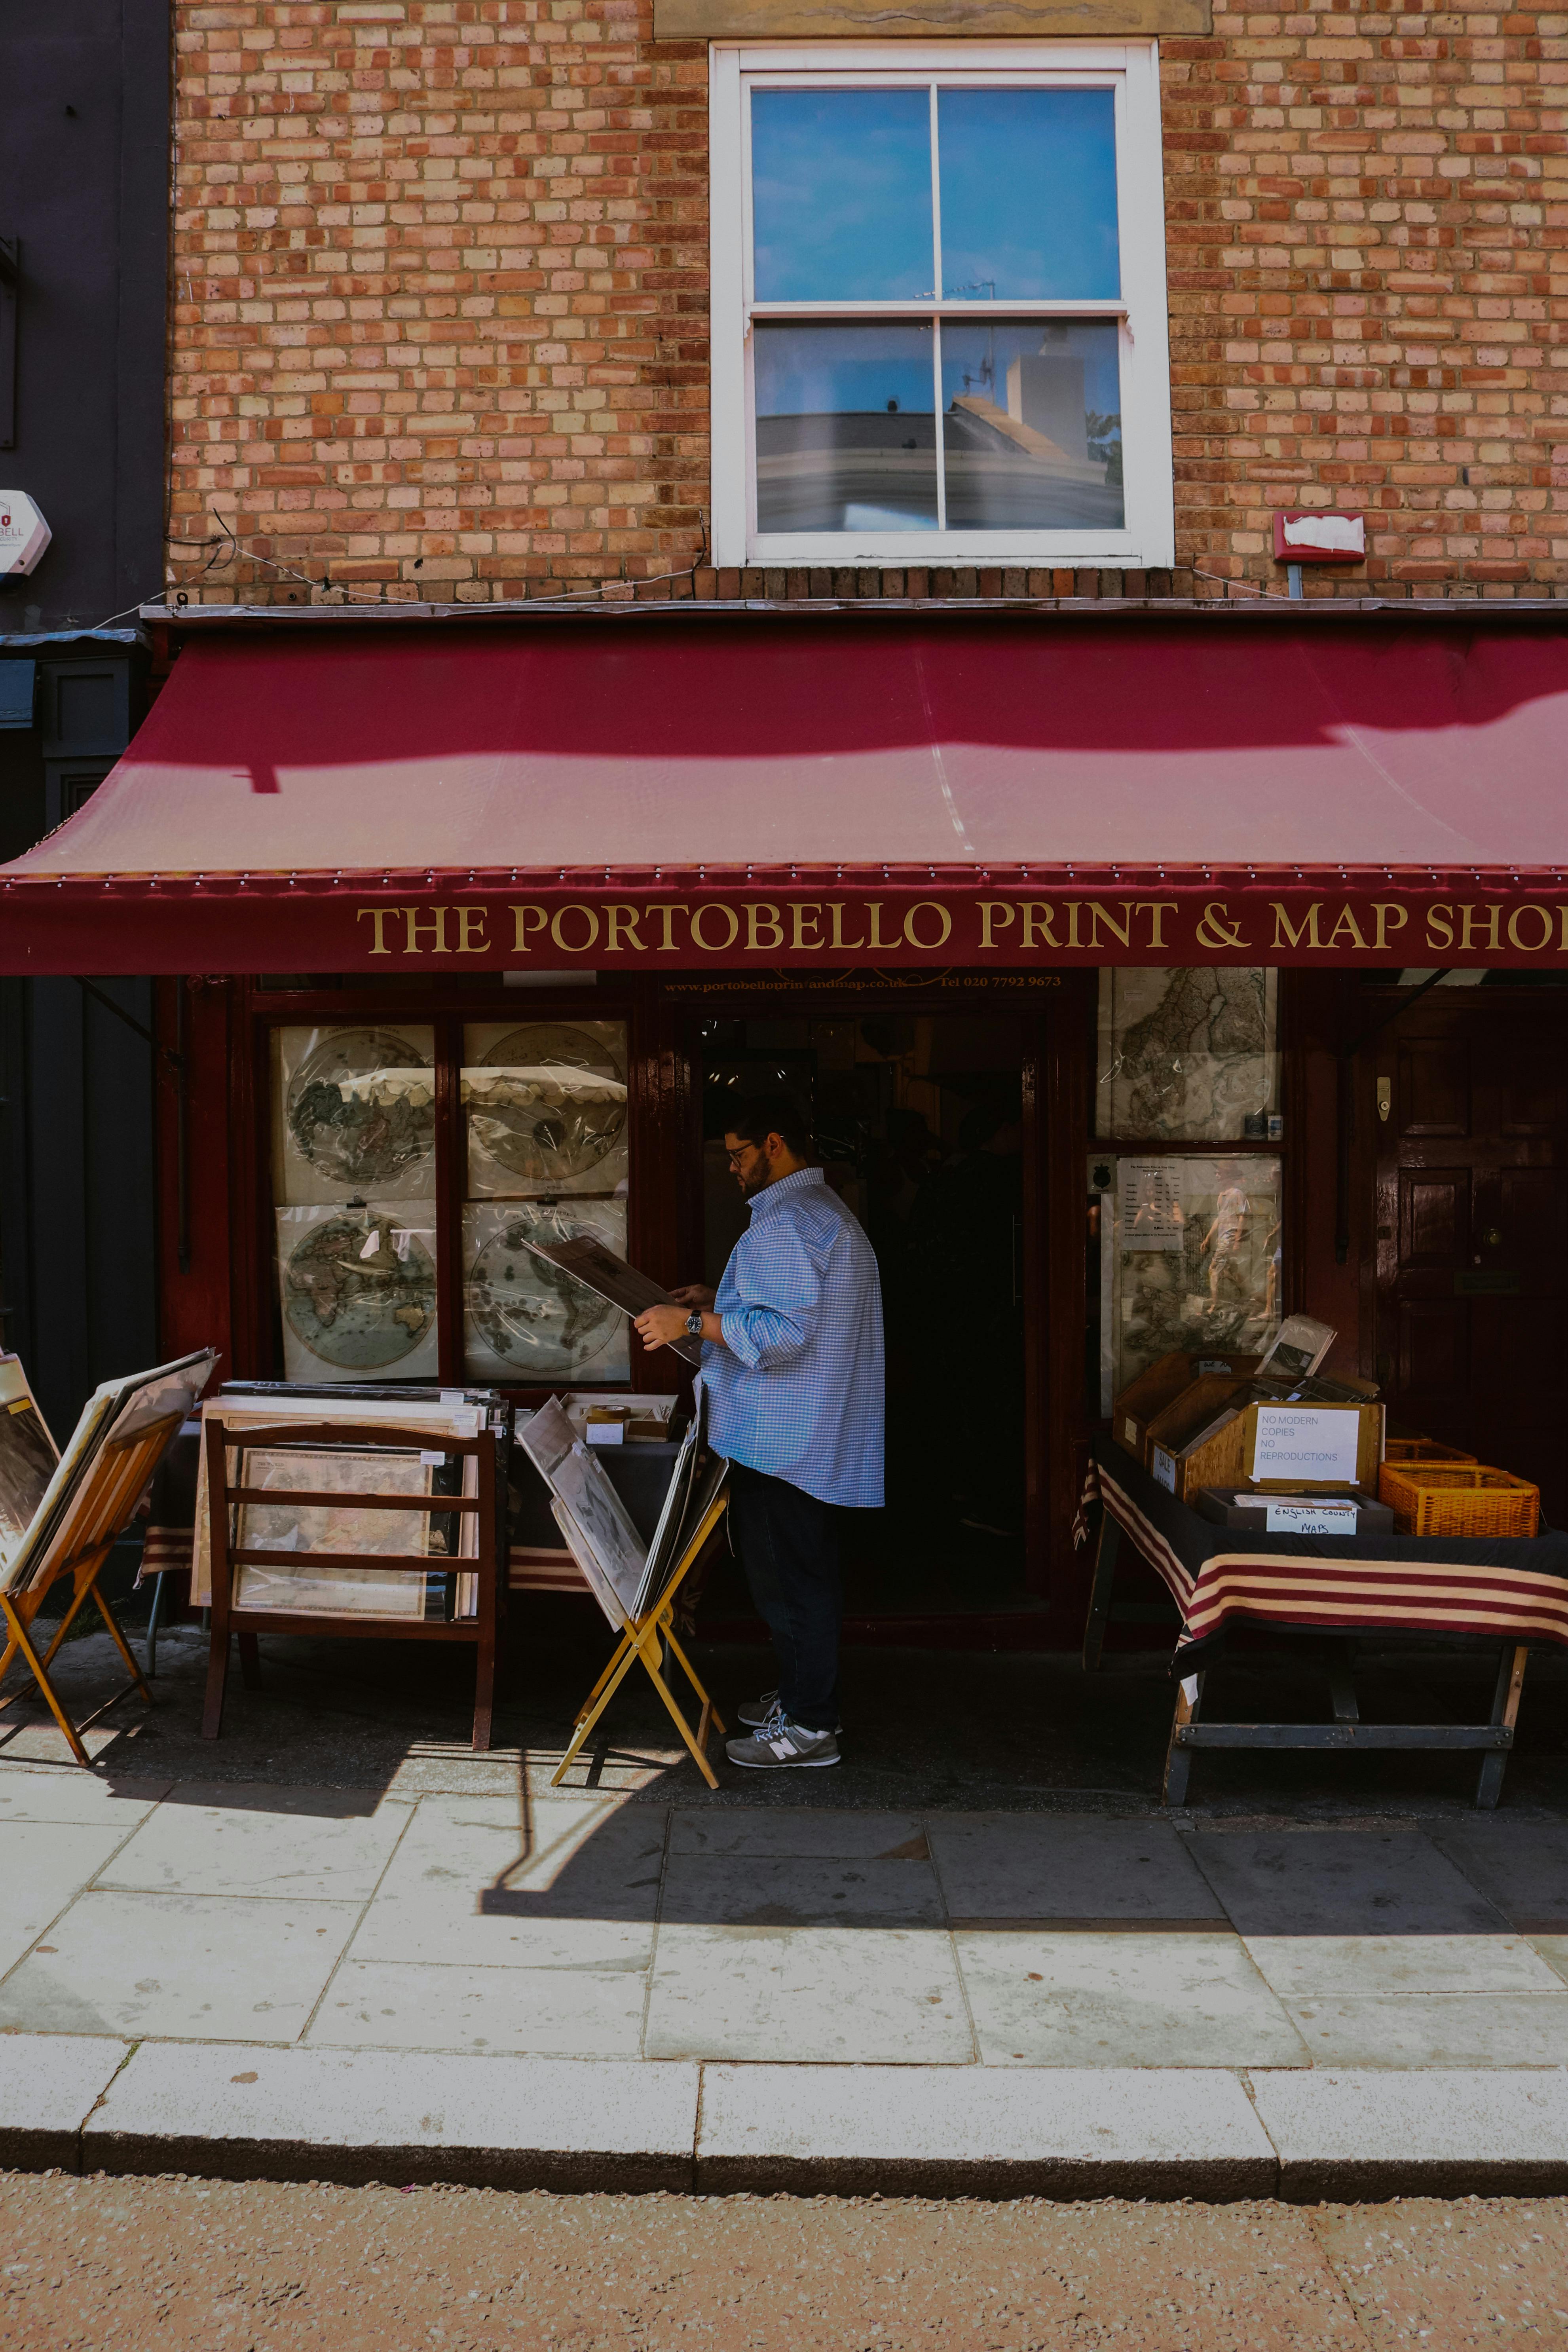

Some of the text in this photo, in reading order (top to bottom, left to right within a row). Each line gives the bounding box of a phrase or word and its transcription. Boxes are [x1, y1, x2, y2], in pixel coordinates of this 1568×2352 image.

[357, 906, 491, 954] THE
[508, 902, 952, 952] PORTOBELLO
[975, 902, 1178, 949] PRINT
[1196, 902, 1252, 948] &
[1268, 903, 1408, 949] MAP
[940, 978, 960, 987] Tel
[964, 978, 988, 987] 020
[992, 977, 1025, 987] 7792
[1028, 976, 1061, 987] 9673
[1278, 1416, 1318, 1425] MODERN
[1261, 1428, 1295, 1437] COPIES
[1261, 1440, 1275, 1448] NO
[1260, 1452, 1338, 1462] REPRODUCTIONS
[1159, 1452, 1170, 1473] SALE
[1275, 1508, 1355, 1519] ENGLISH COUNTY
[1302, 1524, 1329, 1534] MAPS
[769, 1737, 797, 1760] N
